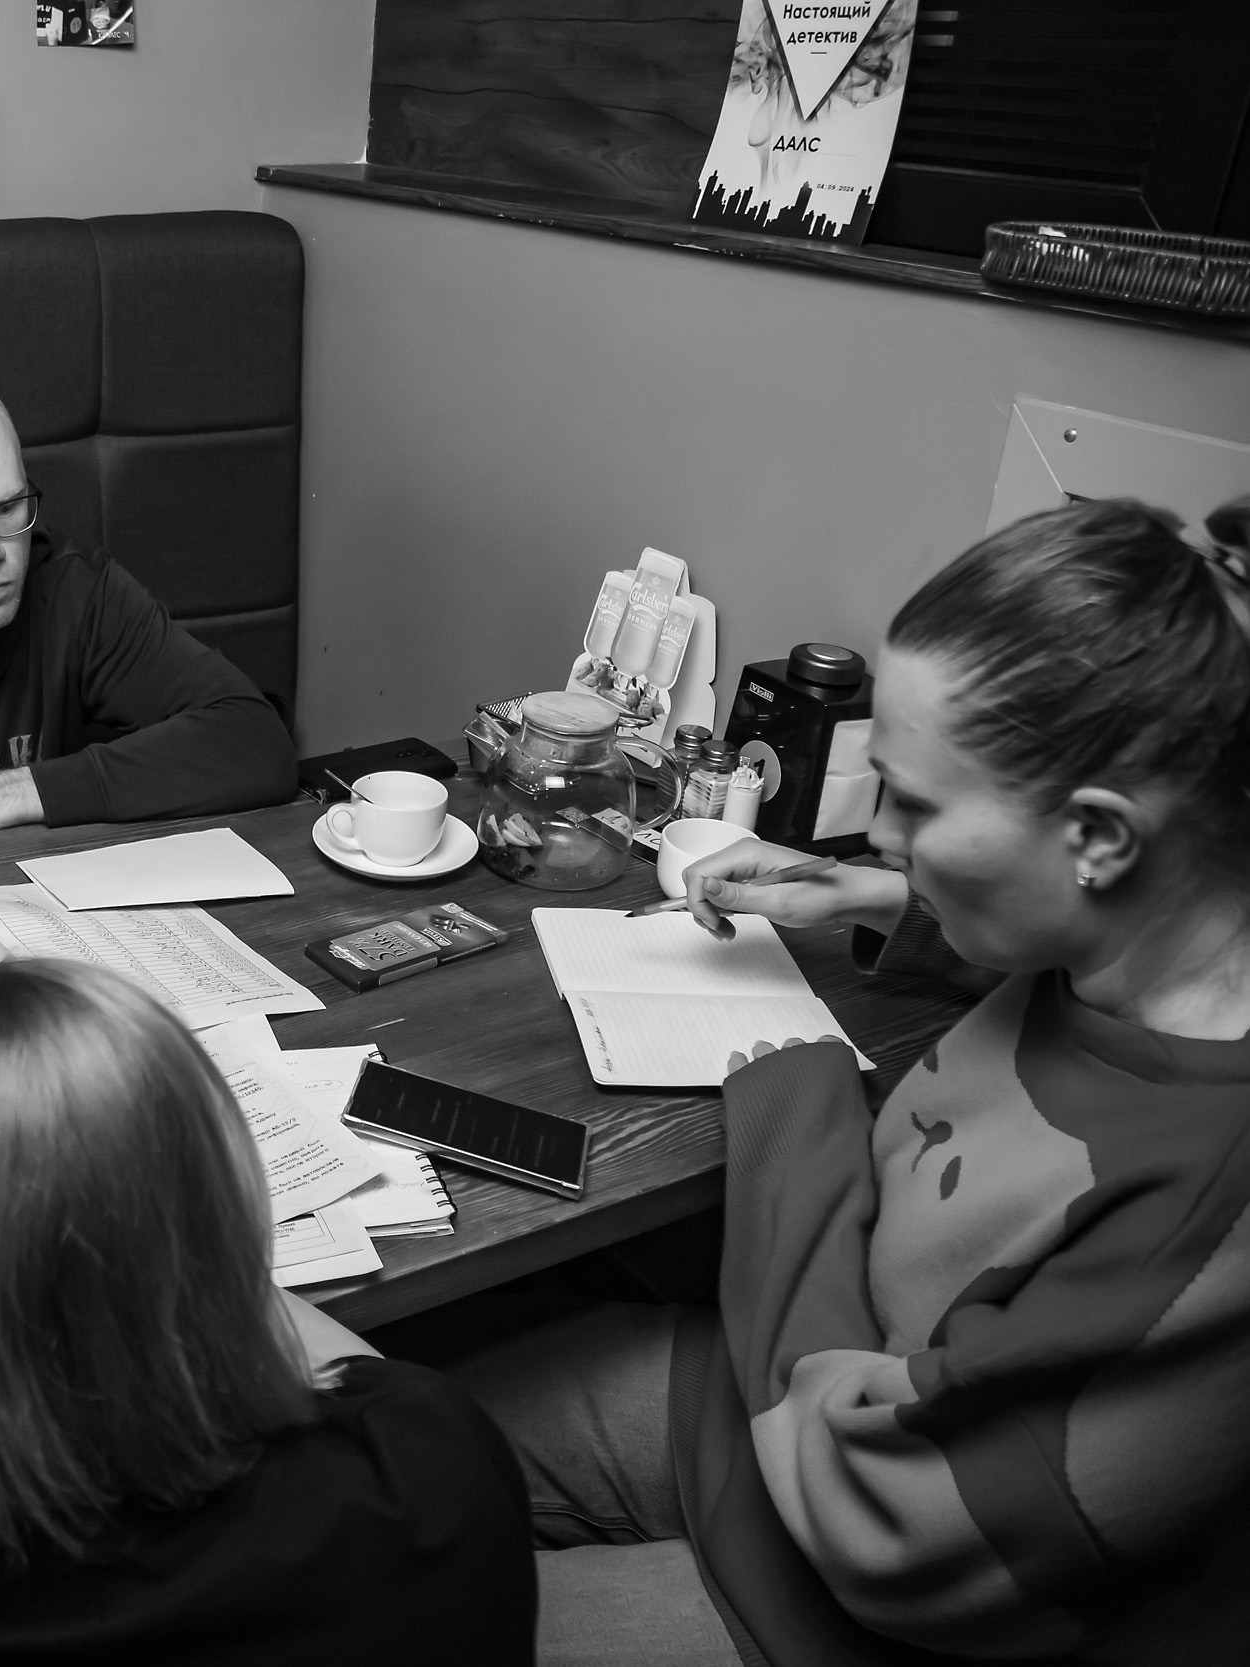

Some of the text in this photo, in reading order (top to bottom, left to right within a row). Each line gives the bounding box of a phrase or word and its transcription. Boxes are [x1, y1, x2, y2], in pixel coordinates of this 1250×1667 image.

[783, 1, 871, 19] Настоящий
[787, 31, 858, 45] детектив
[772, 135, 821, 152] ДАЛС
[629, 582, 670, 615] Carlsberg
[367, 932, 408, 957] DARK
